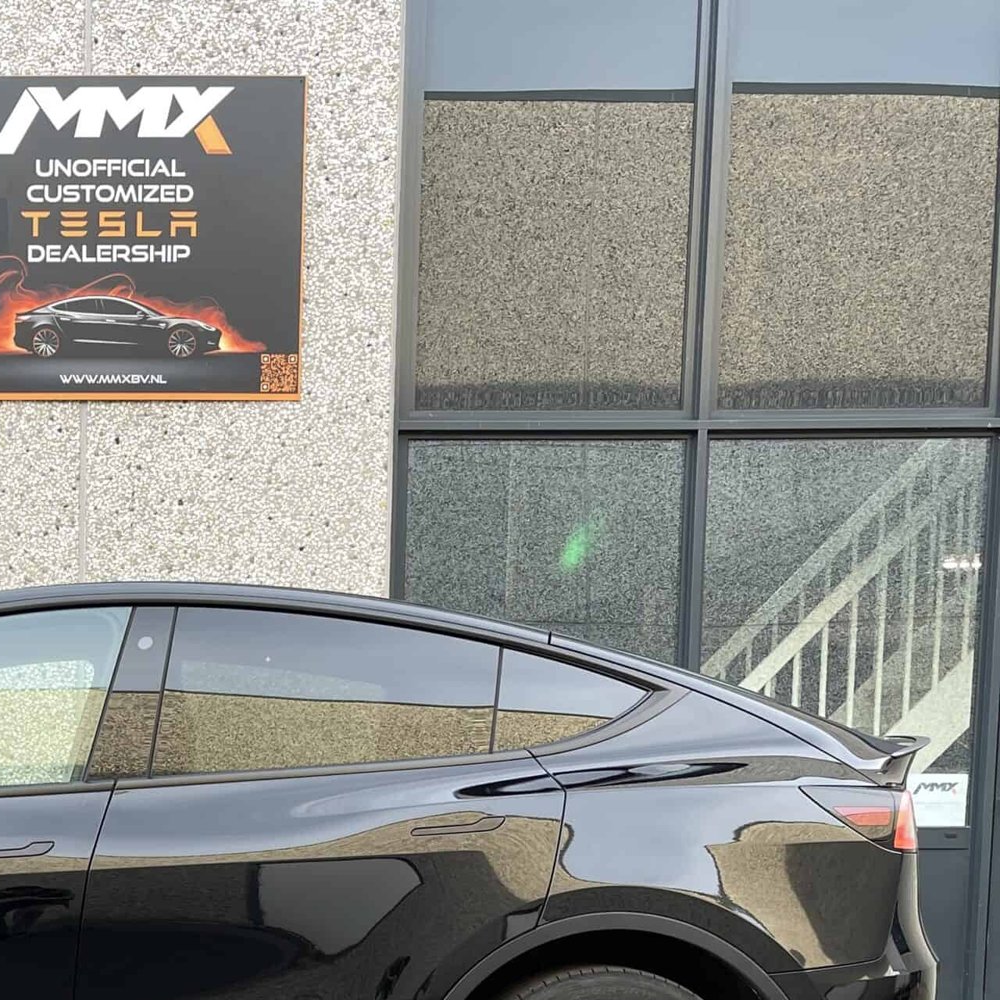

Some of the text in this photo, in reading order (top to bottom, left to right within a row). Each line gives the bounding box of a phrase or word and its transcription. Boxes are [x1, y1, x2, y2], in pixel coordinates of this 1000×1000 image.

[35, 158, 186, 177] UNOFFICIAL
[26, 184, 194, 203] CUSTOMIZED
[20, 210, 198, 238] TESLA
[27, 244, 191, 263] DEALERSHIP
[59, 374, 168, 385] WWW.MMXBV.NL
